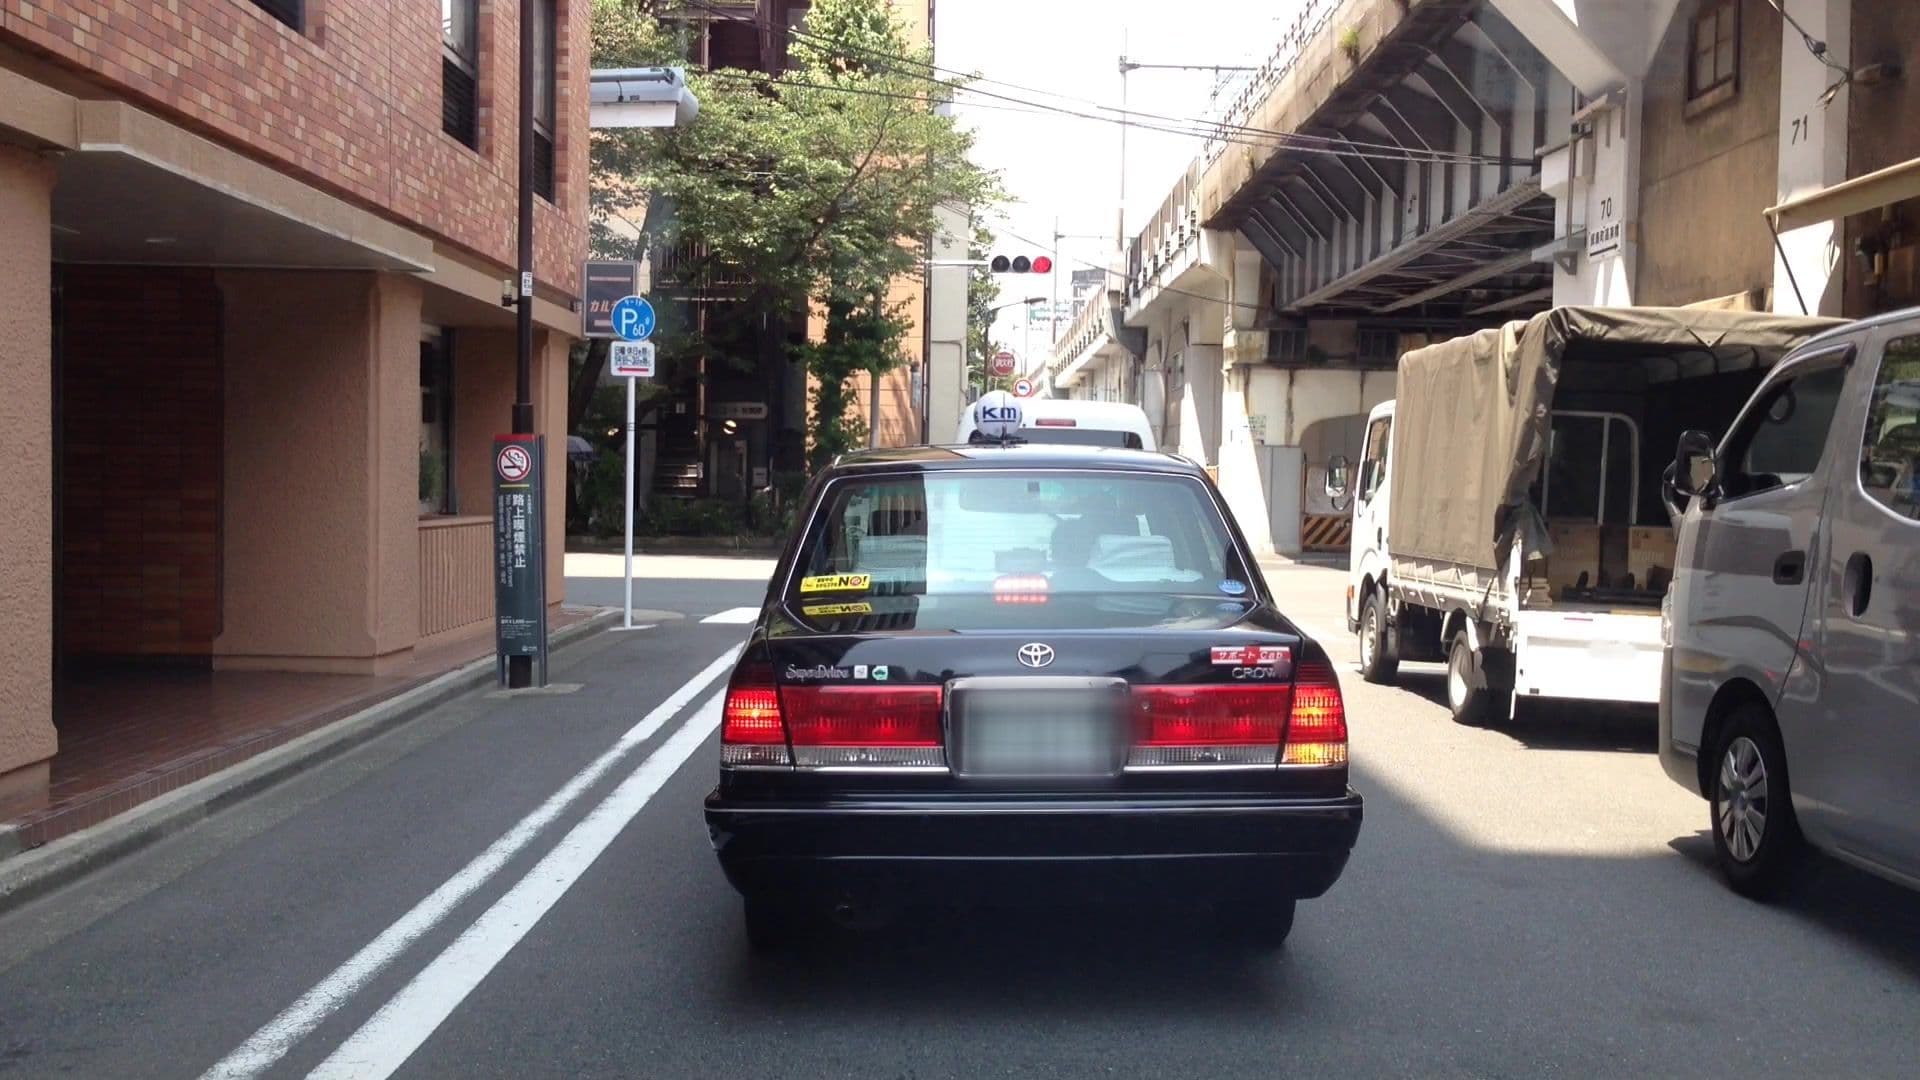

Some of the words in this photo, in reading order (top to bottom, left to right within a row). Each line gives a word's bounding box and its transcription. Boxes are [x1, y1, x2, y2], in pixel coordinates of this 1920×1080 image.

[1792, 115, 1807, 145] 71
[1601, 197, 1611, 220] 70
[621, 308, 638, 336] P
[513, 494, 526, 568] 路上喫煙禁止
